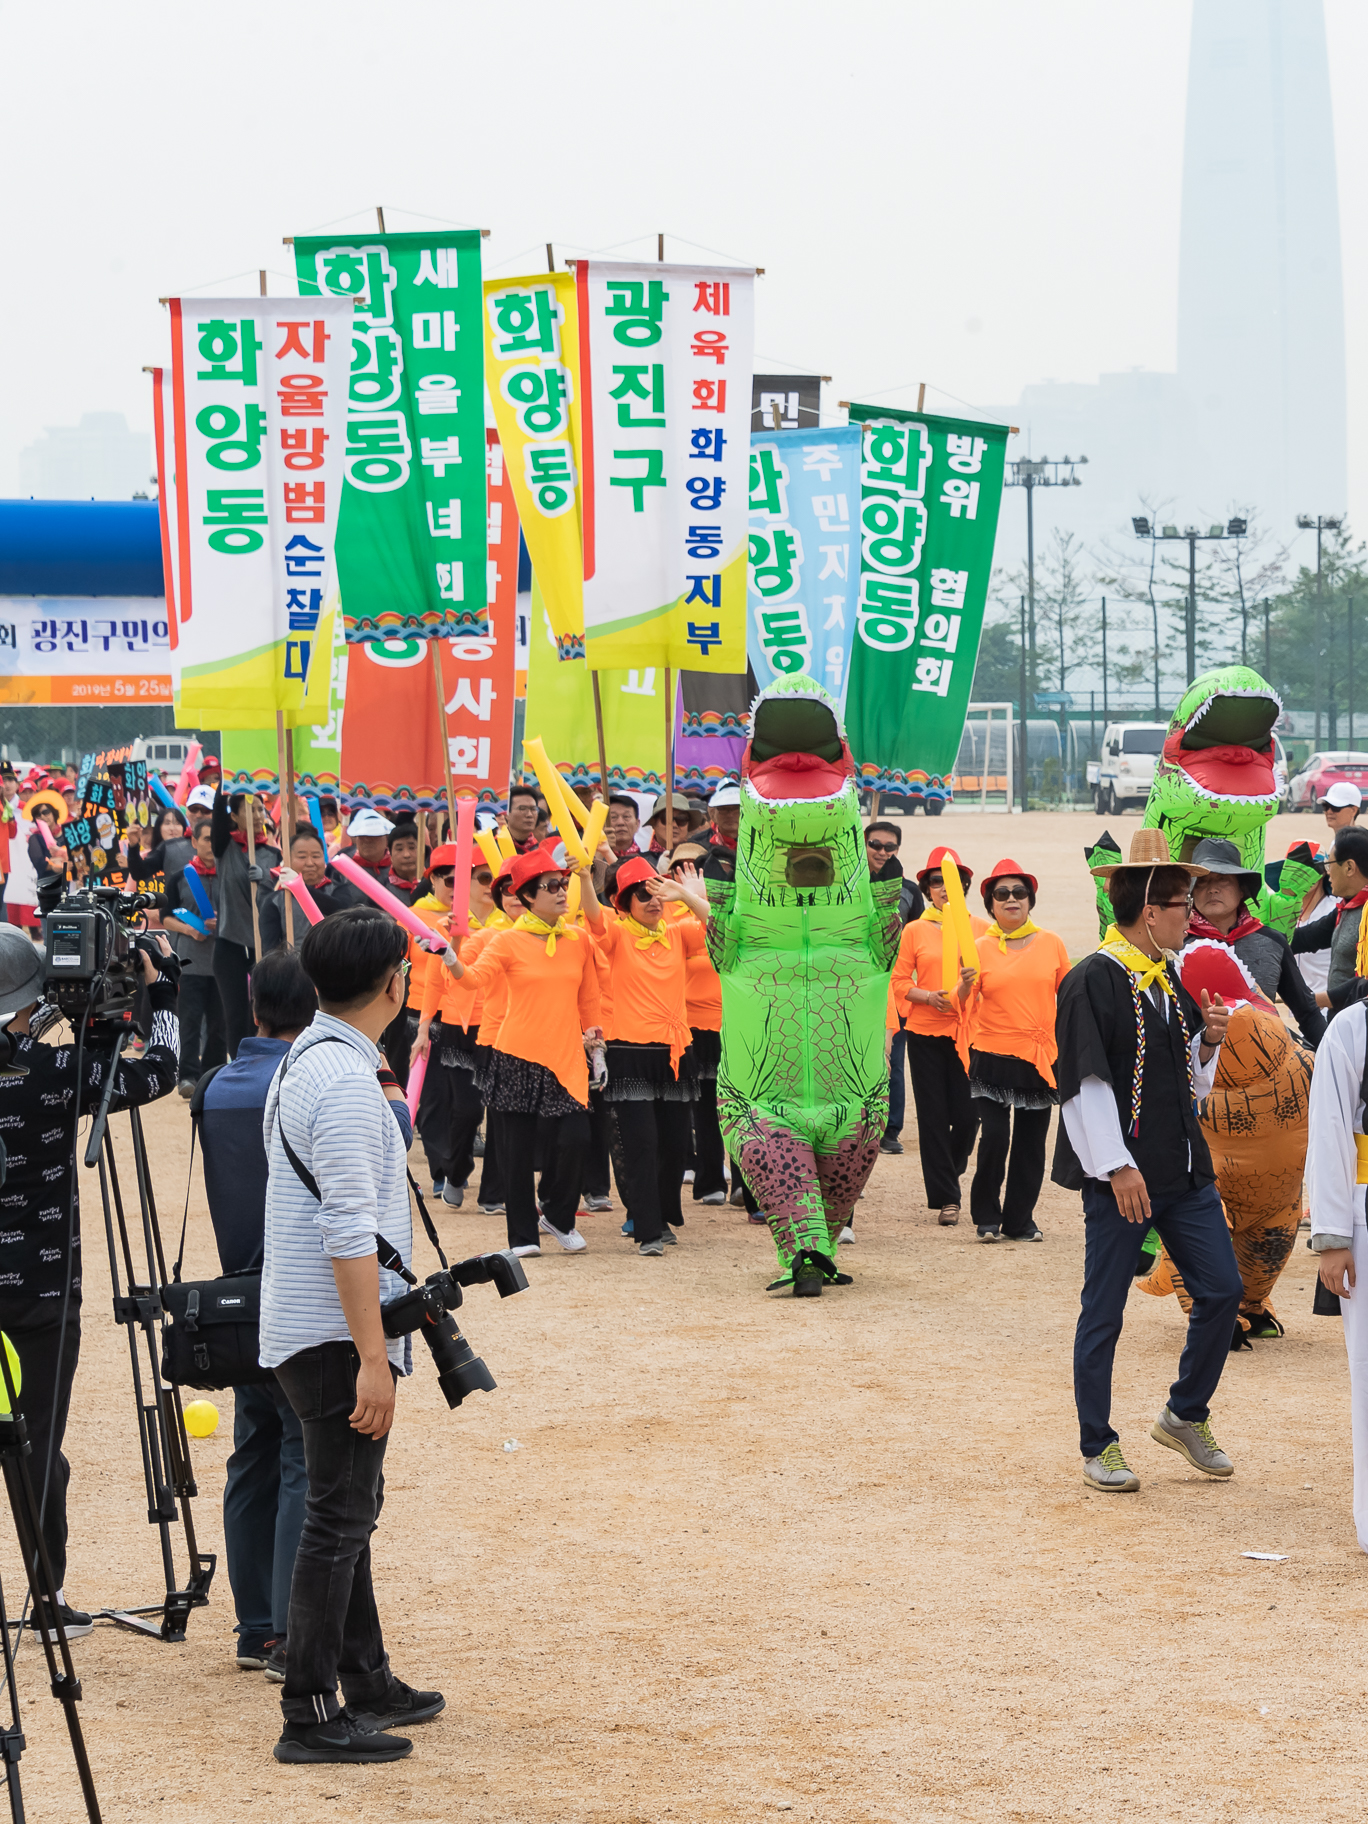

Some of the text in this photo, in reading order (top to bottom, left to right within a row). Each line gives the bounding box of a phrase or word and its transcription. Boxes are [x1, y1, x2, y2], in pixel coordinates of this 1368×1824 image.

[195, 319, 268, 554] 화양동
[488, 285, 573, 516] 화양동
[605, 280, 669, 512] 광진구
[857, 418, 932, 652] 화양동
[912, 433, 987, 696] 방위 협의회
[72, 683, 111, 697] 2019년
[114, 679, 135, 696] 5월
[220, 1297, 241, 1305] Canon
